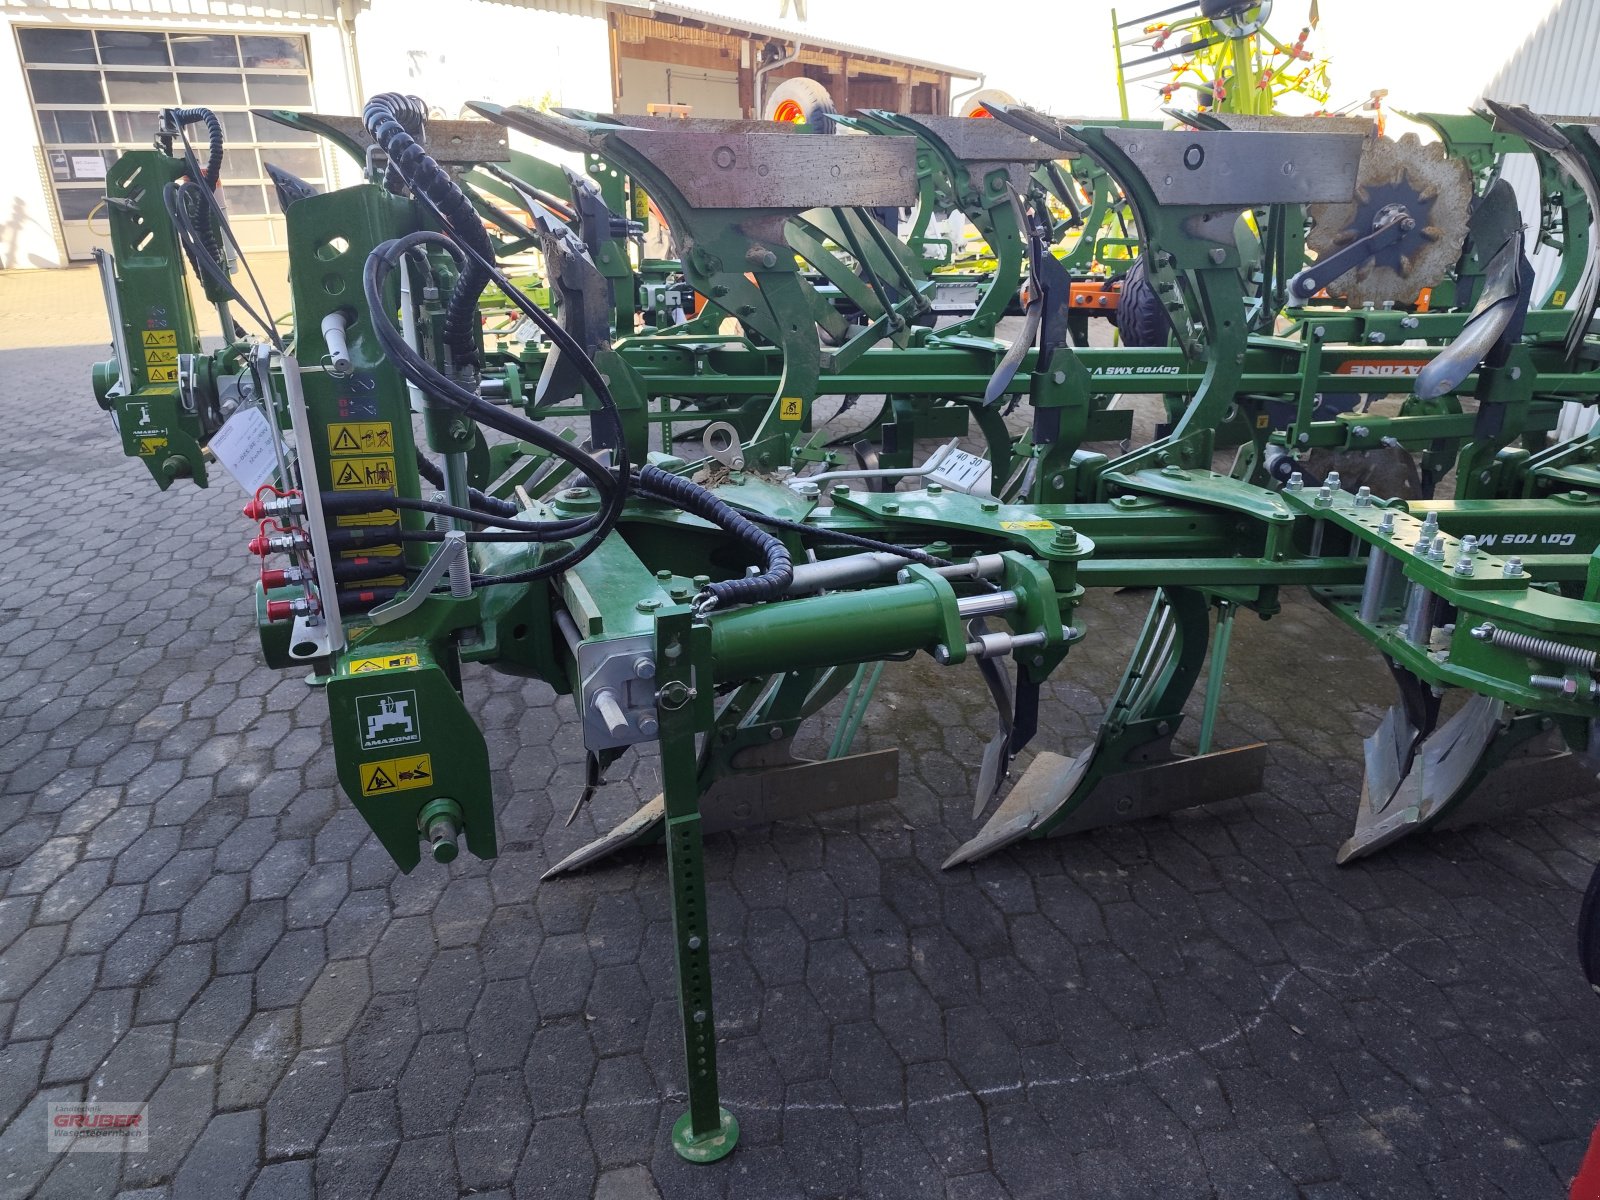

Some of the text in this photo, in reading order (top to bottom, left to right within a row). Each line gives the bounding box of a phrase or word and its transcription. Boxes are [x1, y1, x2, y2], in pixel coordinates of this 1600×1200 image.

[1105, 366, 1135, 375] XMS
[1136, 365, 1180, 375] Cayros
[956, 452, 969, 462] 40
[969, 457, 983, 467] 30
[364, 734, 417, 746] AMAZONE
